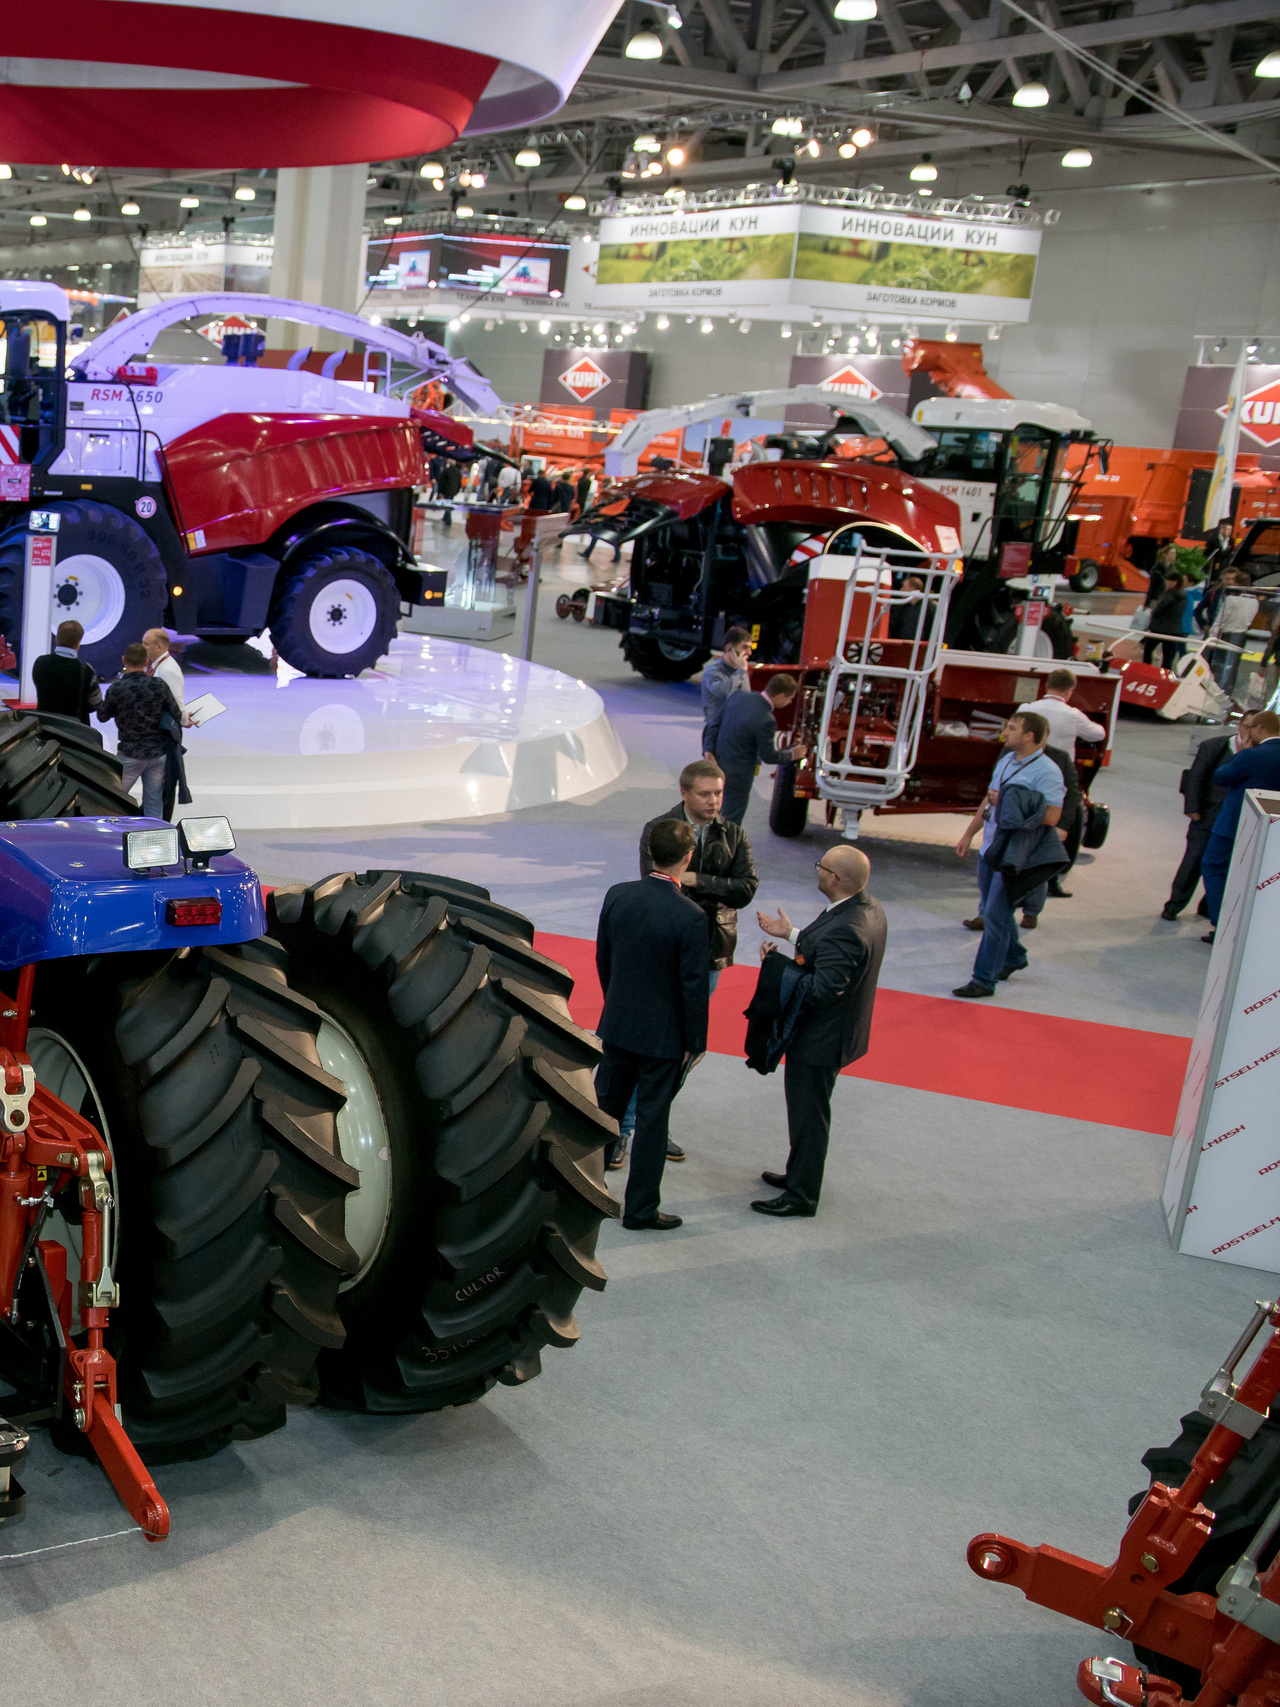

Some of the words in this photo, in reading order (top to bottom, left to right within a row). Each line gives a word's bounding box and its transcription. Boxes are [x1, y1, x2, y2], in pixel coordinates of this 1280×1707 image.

[630, 217, 720, 236] ИННОВАЦИИ
[729, 215, 759, 231] КУН
[842, 216, 955, 242] ИННОВАЦИИ
[965, 229, 999, 246] КУН
[867, 292, 918, 305] ЗАГОТОВКА
[920, 296, 957, 308] КОРМОВ
[566, 371, 603, 388] KUHN
[91, 388, 123, 401] RSM
[126, 390, 163, 403] 2650
[940, 484, 959, 496] RSM
[961, 486, 983, 497] 1401
[140, 502, 152, 513] 20
[1125, 681, 1158, 697] 445
[1243, 989, 1280, 1015] ROST
[455, 1266, 505, 1301] CULTOR
